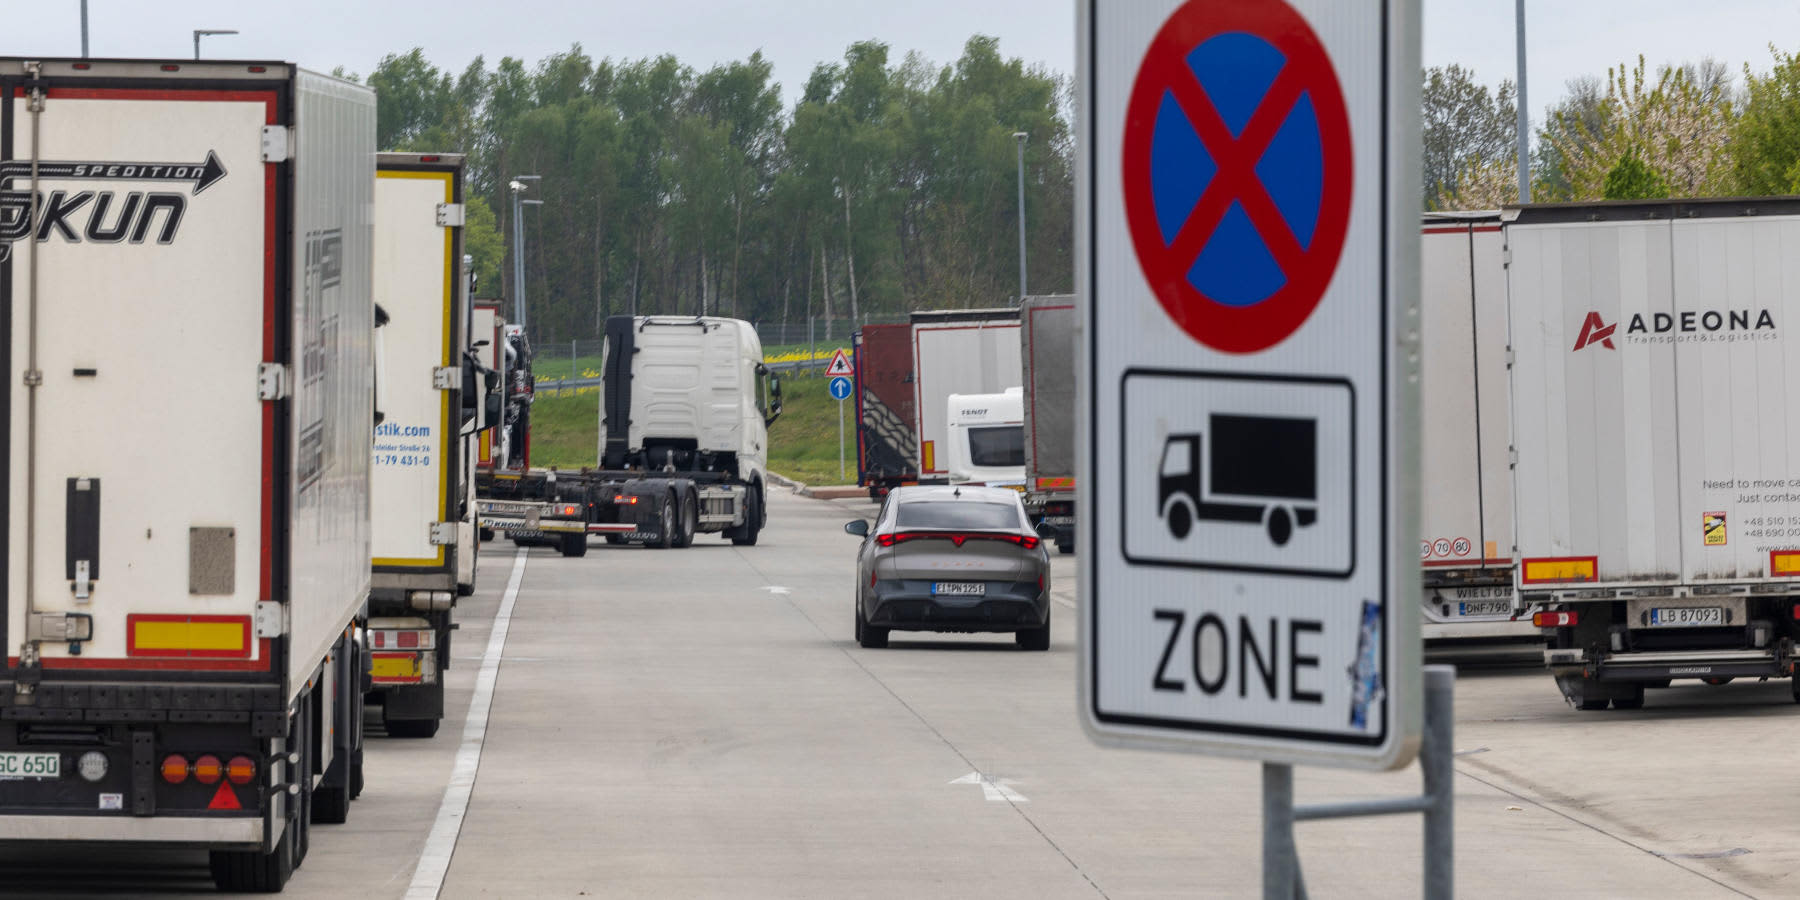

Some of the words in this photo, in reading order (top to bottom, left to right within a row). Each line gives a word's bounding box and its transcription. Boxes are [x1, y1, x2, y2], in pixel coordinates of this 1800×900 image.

[72, 165, 204, 178] SPEDITION
[1627, 309, 1775, 333] ADEONA
[1627, 332, 1777, 344] Transport&Logistics
[377, 423, 430, 437] stik.com
[400, 455, 430, 466] 431-0
[1703, 479, 1734, 489] Need
[1738, 480, 1750, 489] to
[1753, 480, 1785, 488] move
[1737, 493, 1760, 503] Just
[1744, 517, 1763, 526] +48
[1767, 517, 1785, 526] 510
[510, 530, 544, 538] VOLVO
[623, 532, 657, 540] VOLVO
[1744, 529, 1763, 537] +48
[1766, 528, 1785, 537] 690
[1437, 543, 1449, 552] 70
[1456, 541, 1468, 552] 80
[1457, 587, 1513, 599] WIELTON
[1660, 610, 1676, 623] LB
[1680, 609, 1719, 622] 87093
[1153, 608, 1324, 705] ZONE
[23, 756, 58, 774] 650
